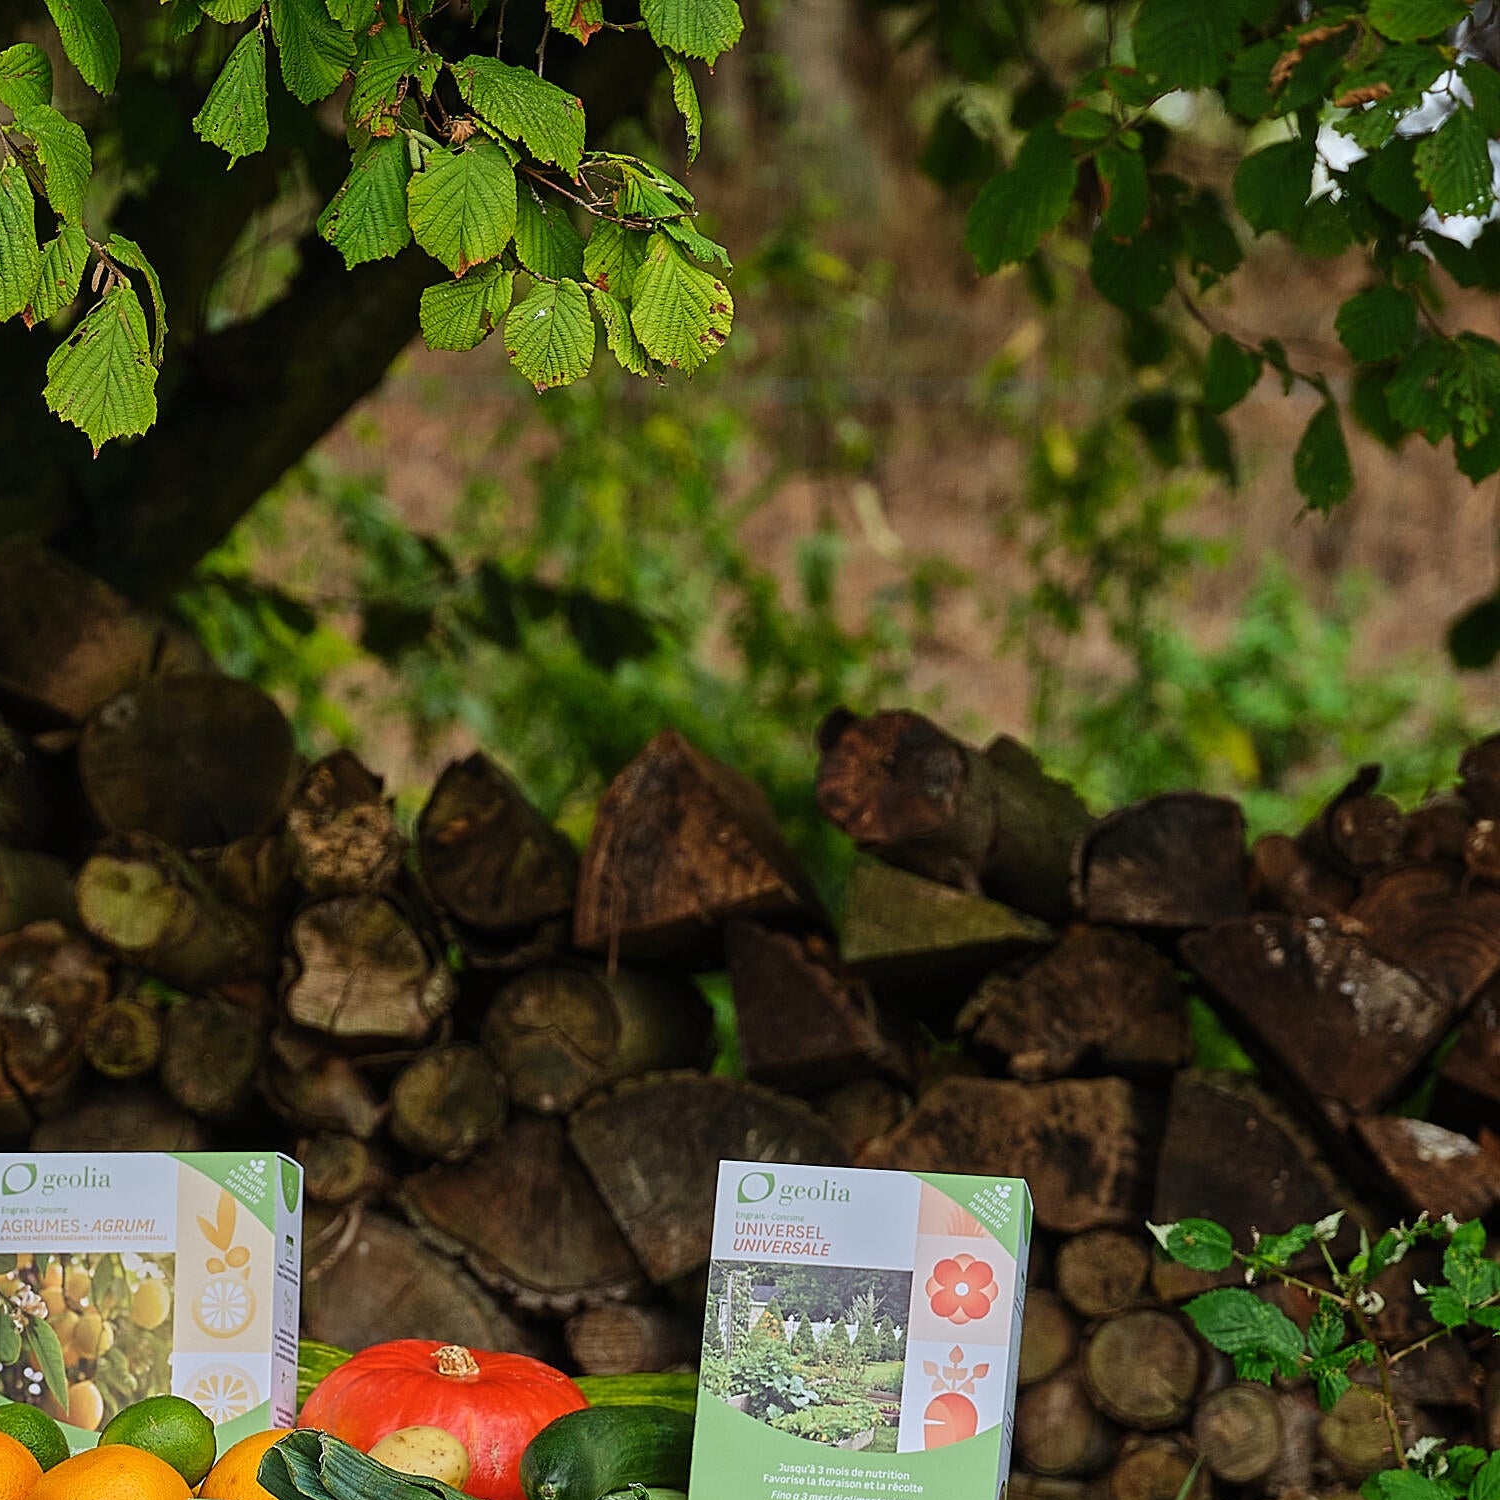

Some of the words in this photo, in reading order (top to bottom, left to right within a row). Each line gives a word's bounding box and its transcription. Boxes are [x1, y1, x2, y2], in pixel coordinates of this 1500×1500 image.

[42, 1166, 110, 1196] geolia
[229, 1169, 266, 1198] naturelle
[239, 1164, 267, 1187] origine
[225, 1178, 259, 1205] naturale
[779, 1179, 850, 1206] geolia
[983, 1189, 1011, 1212] origine
[1, 1207, 29, 1215] Engrais
[736, 1211, 765, 1220] Engrais
[771, 1212, 804, 1221] Concime
[968, 1201, 1002, 1229] naturale
[973, 1192, 1009, 1223] naturelle
[1, 1220, 80, 1233] AGRUMES
[92, 1219, 155, 1232] AGRUMI
[735, 1222, 824, 1240] UNIVERSEL
[733, 1239, 831, 1256] UNIVERSALE
[778, 1462, 815, 1475] Jusqu'à
[817, 1465, 824, 1474] 3
[827, 1466, 849, 1476] mois
[851, 1467, 864, 1477] de
[865, 1470, 910, 1480] nutrition
[763, 1473, 805, 1485] Favorise
[806, 1476, 816, 1486] la
[818, 1476, 862, 1488] floraison
[863, 1481, 874, 1490] et
[876, 1481, 885, 1490] la
[887, 1481, 923, 1493] récolte
[770, 1490, 792, 1500] Fino
[800, 1492, 808, 1500] 3
